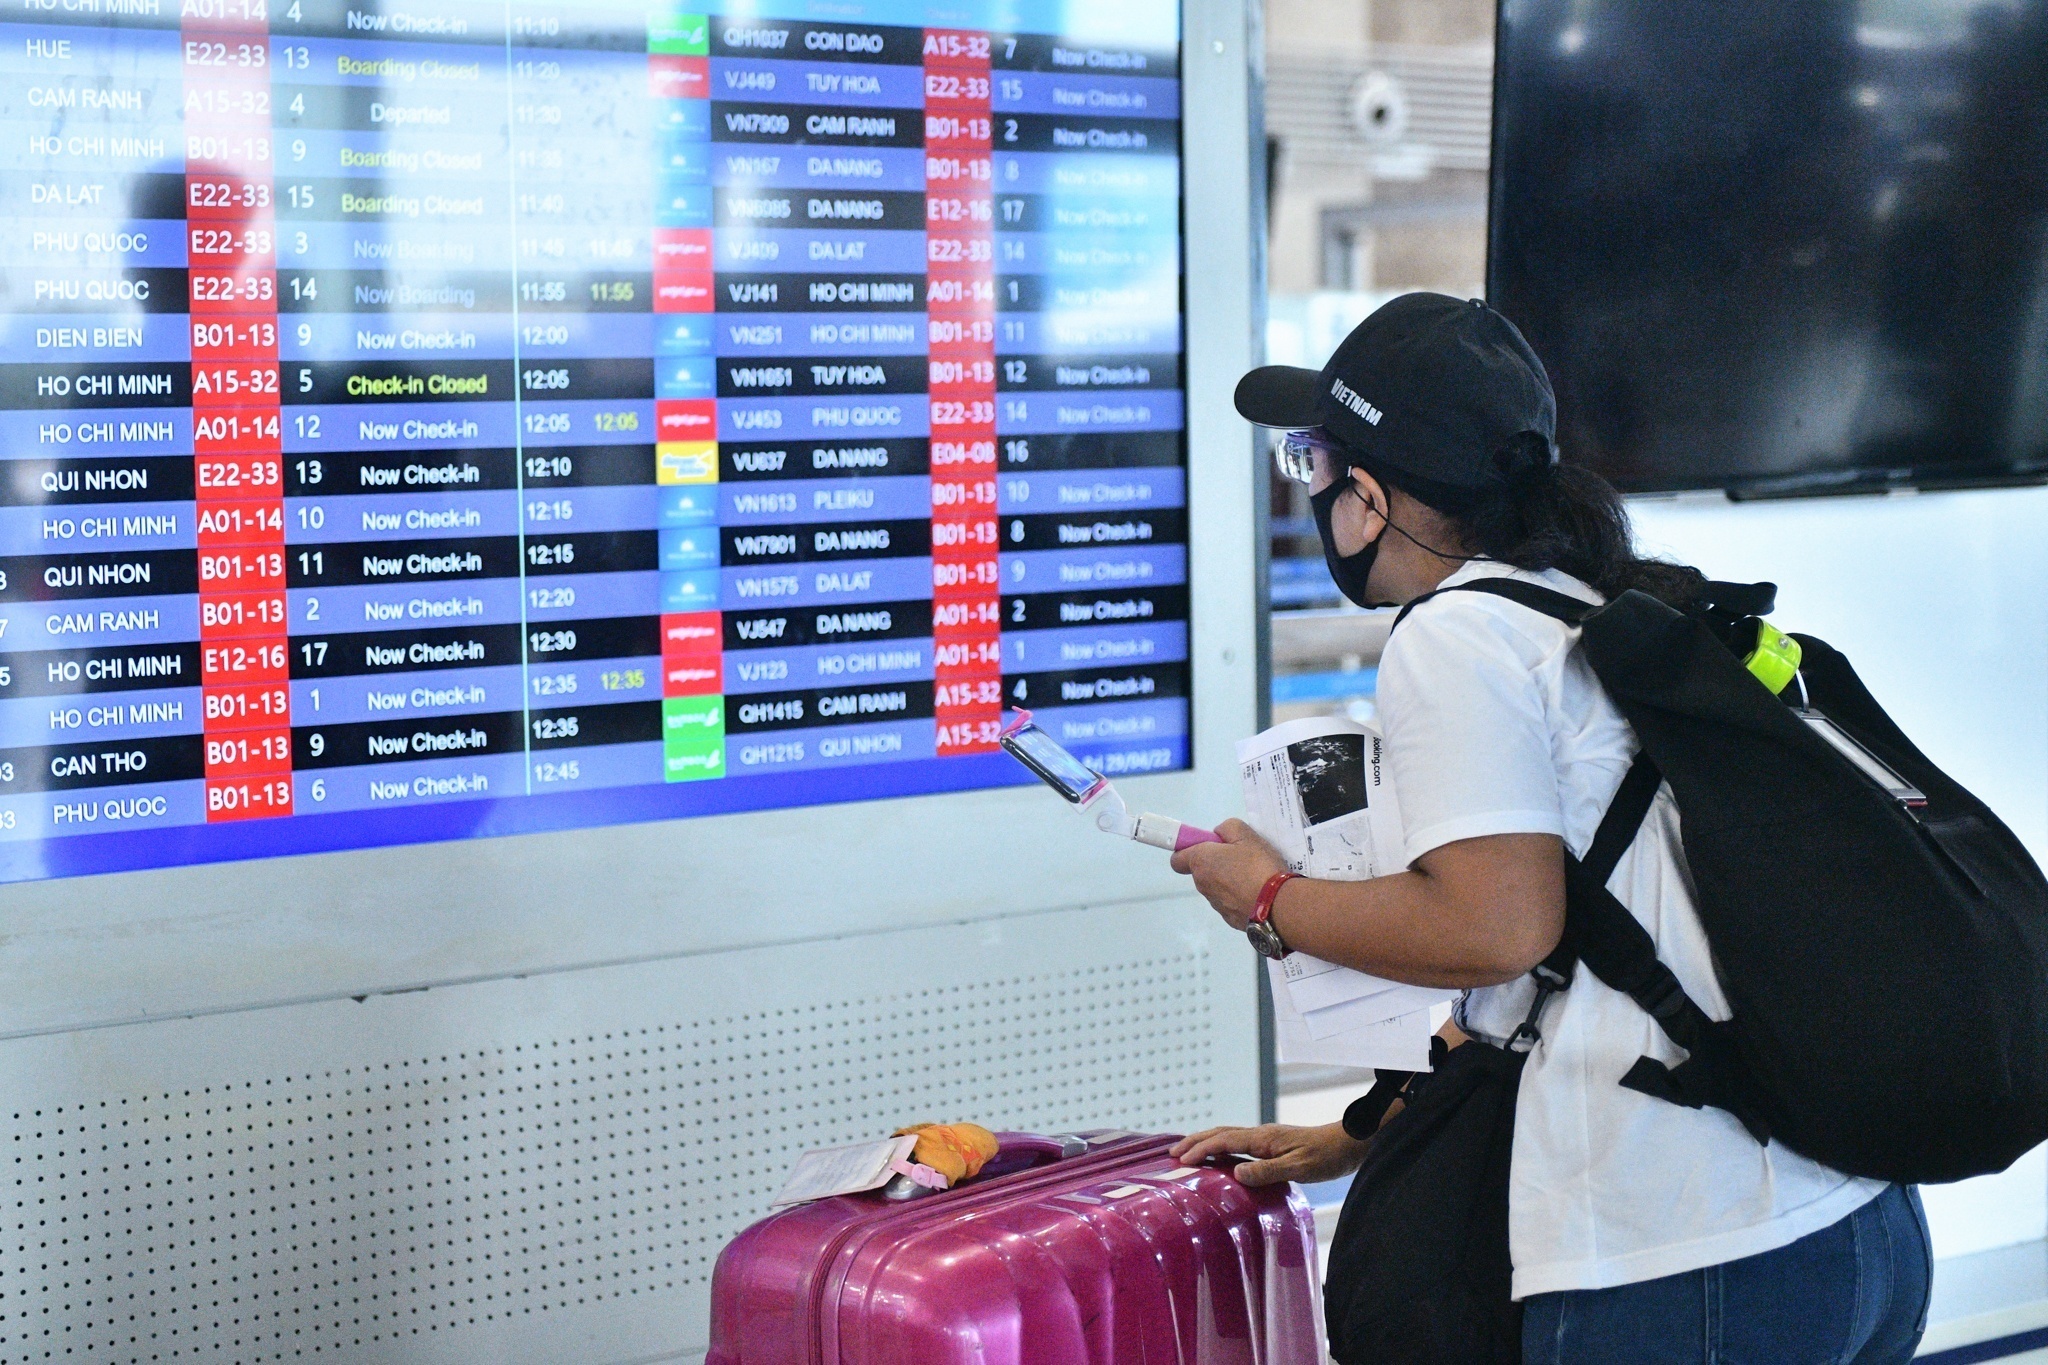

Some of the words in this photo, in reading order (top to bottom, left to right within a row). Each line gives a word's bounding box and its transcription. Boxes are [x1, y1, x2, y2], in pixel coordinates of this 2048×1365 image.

[181, 0, 266, 20] A01-14
[287, 0, 302, 22] 4
[26, 38, 71, 59] HUE
[186, 42, 266, 66] E22-33
[284, 47, 309, 68] 13
[338, 56, 415, 81] Boarding
[420, 60, 479, 80] Closed
[922, 36, 990, 58] A15-32
[1005, 39, 1016, 59] 7
[28, 88, 76, 108] CAM
[82, 88, 142, 110] RANH
[186, 90, 270, 114] A15-32
[290, 93, 304, 115] 4
[926, 76, 989, 98] E22-33
[1001, 80, 1022, 100] 15
[927, 117, 990, 140] B01-13
[1005, 120, 1018, 141] 2
[30, 136, 62, 156] HO
[67, 136, 104, 156] CHI
[111, 137, 164, 158] MINH
[188, 137, 270, 160] B01-13
[292, 140, 306, 160] 9
[927, 158, 992, 180] B01-13
[32, 184, 62, 204] DA
[67, 184, 103, 205] LAT
[190, 184, 270, 206] E22-33
[288, 186, 314, 208] 15
[928, 199, 991, 220] E12-16
[1002, 201, 1024, 220] 17
[34, 232, 77, 252] PHU
[86, 233, 147, 252] QUOC
[192, 231, 271, 253] E22-33
[295, 232, 308, 254] 3
[928, 240, 990, 261] E22-33
[36, 280, 78, 300] PHU
[87, 281, 149, 300] QUOC
[194, 278, 272, 300] E22-33
[291, 278, 316, 300] 14
[810, 284, 835, 301] HO
[838, 284, 868, 301] CHI
[871, 284, 913, 301] MINH
[927, 281, 994, 302] A01-14
[37, 328, 86, 348] DIEN
[94, 328, 142, 348] BIEN
[194, 324, 275, 347] B01-13
[298, 324, 310, 346] 9
[358, 331, 396, 349] Now
[401, 330, 475, 349] Check-in
[524, 326, 568, 344] 12:00
[930, 321, 993, 342] B01-13
[38, 376, 69, 396] HO
[76, 376, 112, 396] CHI
[118, 376, 172, 395] MINH
[194, 370, 278, 394] A15-32
[300, 370, 312, 392] 5
[348, 375, 423, 395] Check-in
[428, 374, 486, 394] Closed
[524, 369, 569, 389] 12:05
[812, 367, 848, 384] TUY
[850, 366, 885, 384] HOA
[930, 362, 994, 383] B01-13
[1330, 377, 1384, 427] VIETNAM
[40, 424, 70, 443] HO
[77, 424, 114, 442] CHI
[120, 423, 173, 442] MINH
[195, 416, 279, 440] A01-14
[296, 416, 320, 438] 12
[525, 414, 570, 432] 12:05
[594, 412, 638, 431] 12:05
[931, 402, 994, 424] E22-33
[44, 472, 78, 491] QUI
[85, 470, 147, 490] NHON
[200, 462, 278, 486] E22-33
[296, 460, 322, 484] 13
[361, 466, 399, 486] Now
[404, 464, 478, 484] Check-in
[526, 458, 572, 477] 12:10
[813, 450, 837, 468] DA
[838, 448, 888, 467] NANG
[528, 501, 572, 520] 12:15
[933, 483, 996, 504] B01-13
[44, 519, 74, 538] HO
[81, 518, 117, 537] CHI
[124, 516, 176, 536] MINH
[198, 508, 282, 532] A01-14
[299, 506, 324, 530] 10
[528, 544, 574, 564] 12:15
[815, 533, 839, 551] DA
[840, 530, 889, 550] NANG
[934, 522, 998, 546] B01-13
[44, 566, 82, 587] QUI
[88, 564, 150, 585] NHON
[202, 555, 282, 579] B01-13
[300, 552, 322, 575] 11
[364, 556, 402, 576] Now
[406, 553, 482, 574] Check-in
[530, 588, 575, 608] 12:20
[934, 562, 998, 585] B01-13
[47, 614, 92, 634] CAM
[100, 611, 158, 630] RANH
[203, 600, 284, 625] B01-13
[306, 598, 320, 620] 2
[530, 631, 576, 652] 12:30
[817, 615, 840, 633] DA
[841, 612, 891, 632] NANG
[933, 602, 1000, 626] A01-14
[48, 662, 80, 682] HO
[88, 659, 122, 680] CHI
[128, 656, 181, 677] MINH
[206, 646, 285, 672] E12-16
[302, 643, 328, 666] 17
[366, 646, 404, 666] Now
[410, 642, 484, 662] Check-in
[532, 674, 577, 695] 12:35
[601, 670, 644, 690] 12:35
[934, 642, 1000, 666] A01-14
[51, 708, 82, 728] HO
[88, 706, 124, 726] CHI
[130, 702, 182, 722] MINH
[206, 692, 286, 717] B01-13
[311, 690, 320, 710] 1
[532, 718, 578, 738] 12:35
[819, 696, 858, 715] CAM
[860, 692, 906, 712] RANH
[934, 682, 1000, 706] A15-32
[52, 755, 96, 776] CAN
[102, 752, 146, 772] THO
[208, 738, 288, 764] B01-13
[310, 734, 324, 756] 9
[369, 736, 408, 756] Now
[412, 729, 487, 752] Check-in
[535, 761, 580, 782] 12:45
[936, 722, 1001, 746] A15-32
[54, 802, 98, 823] PHU
[104, 797, 166, 820] QUOC
[210, 784, 289, 810] B01-13
[312, 780, 326, 802] 6
[371, 781, 408, 800] Now
[413, 774, 488, 796] Check-in
